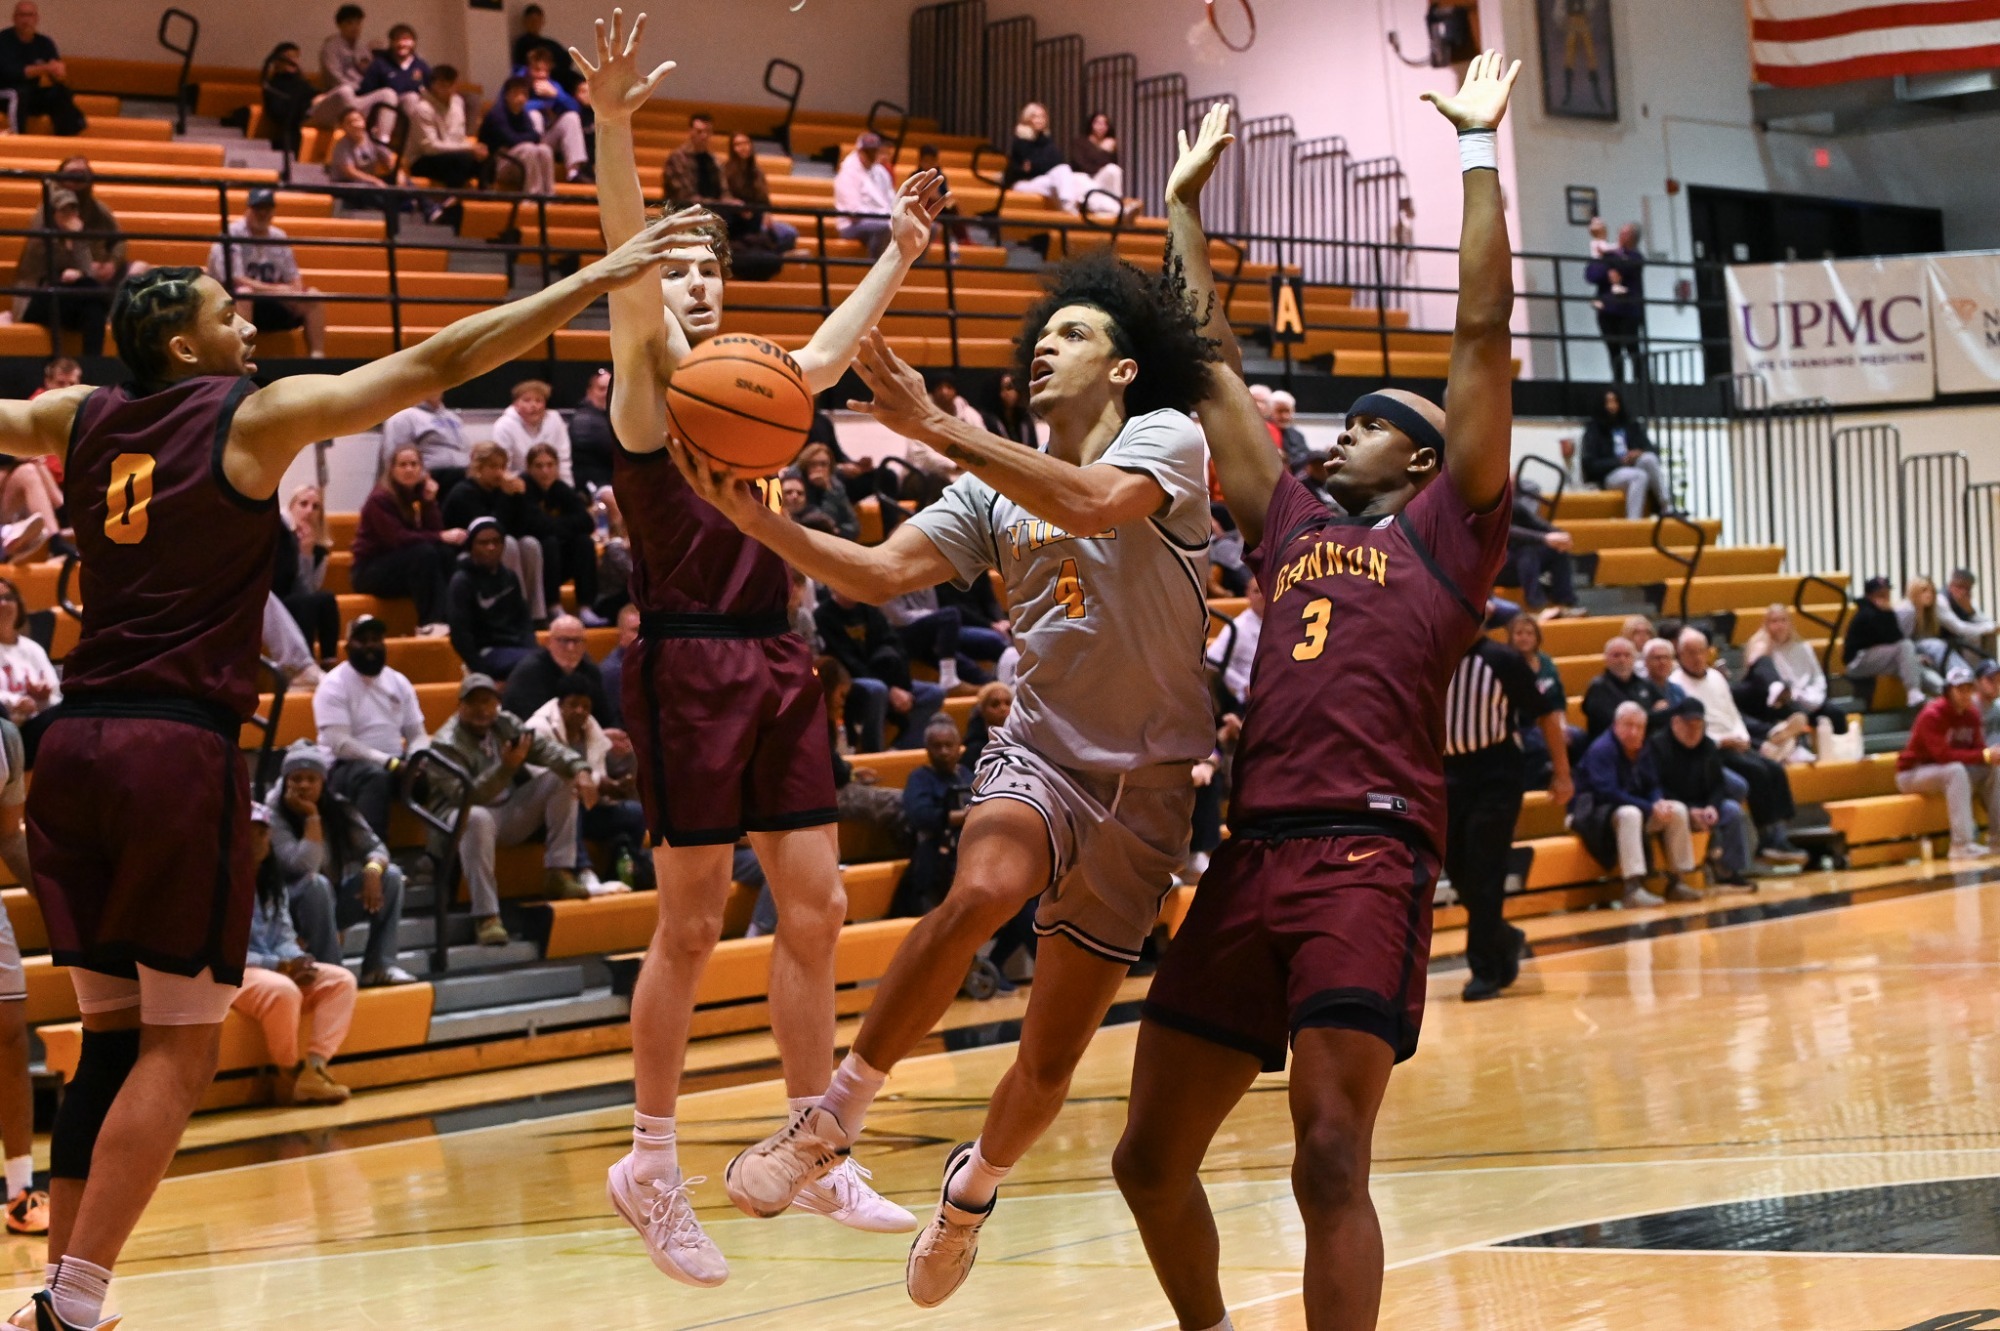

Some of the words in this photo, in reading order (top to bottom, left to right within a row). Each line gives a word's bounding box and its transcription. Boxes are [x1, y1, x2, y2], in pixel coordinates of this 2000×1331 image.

[1276, 286, 1303, 334] A
[1741, 295, 1925, 351] UPMC
[104, 453, 156, 544] 0
[1007, 519, 1116, 560] VIL
[1053, 558, 1086, 619] 4
[1273, 541, 1388, 602] GANNON
[1292, 597, 1332, 661] 3
